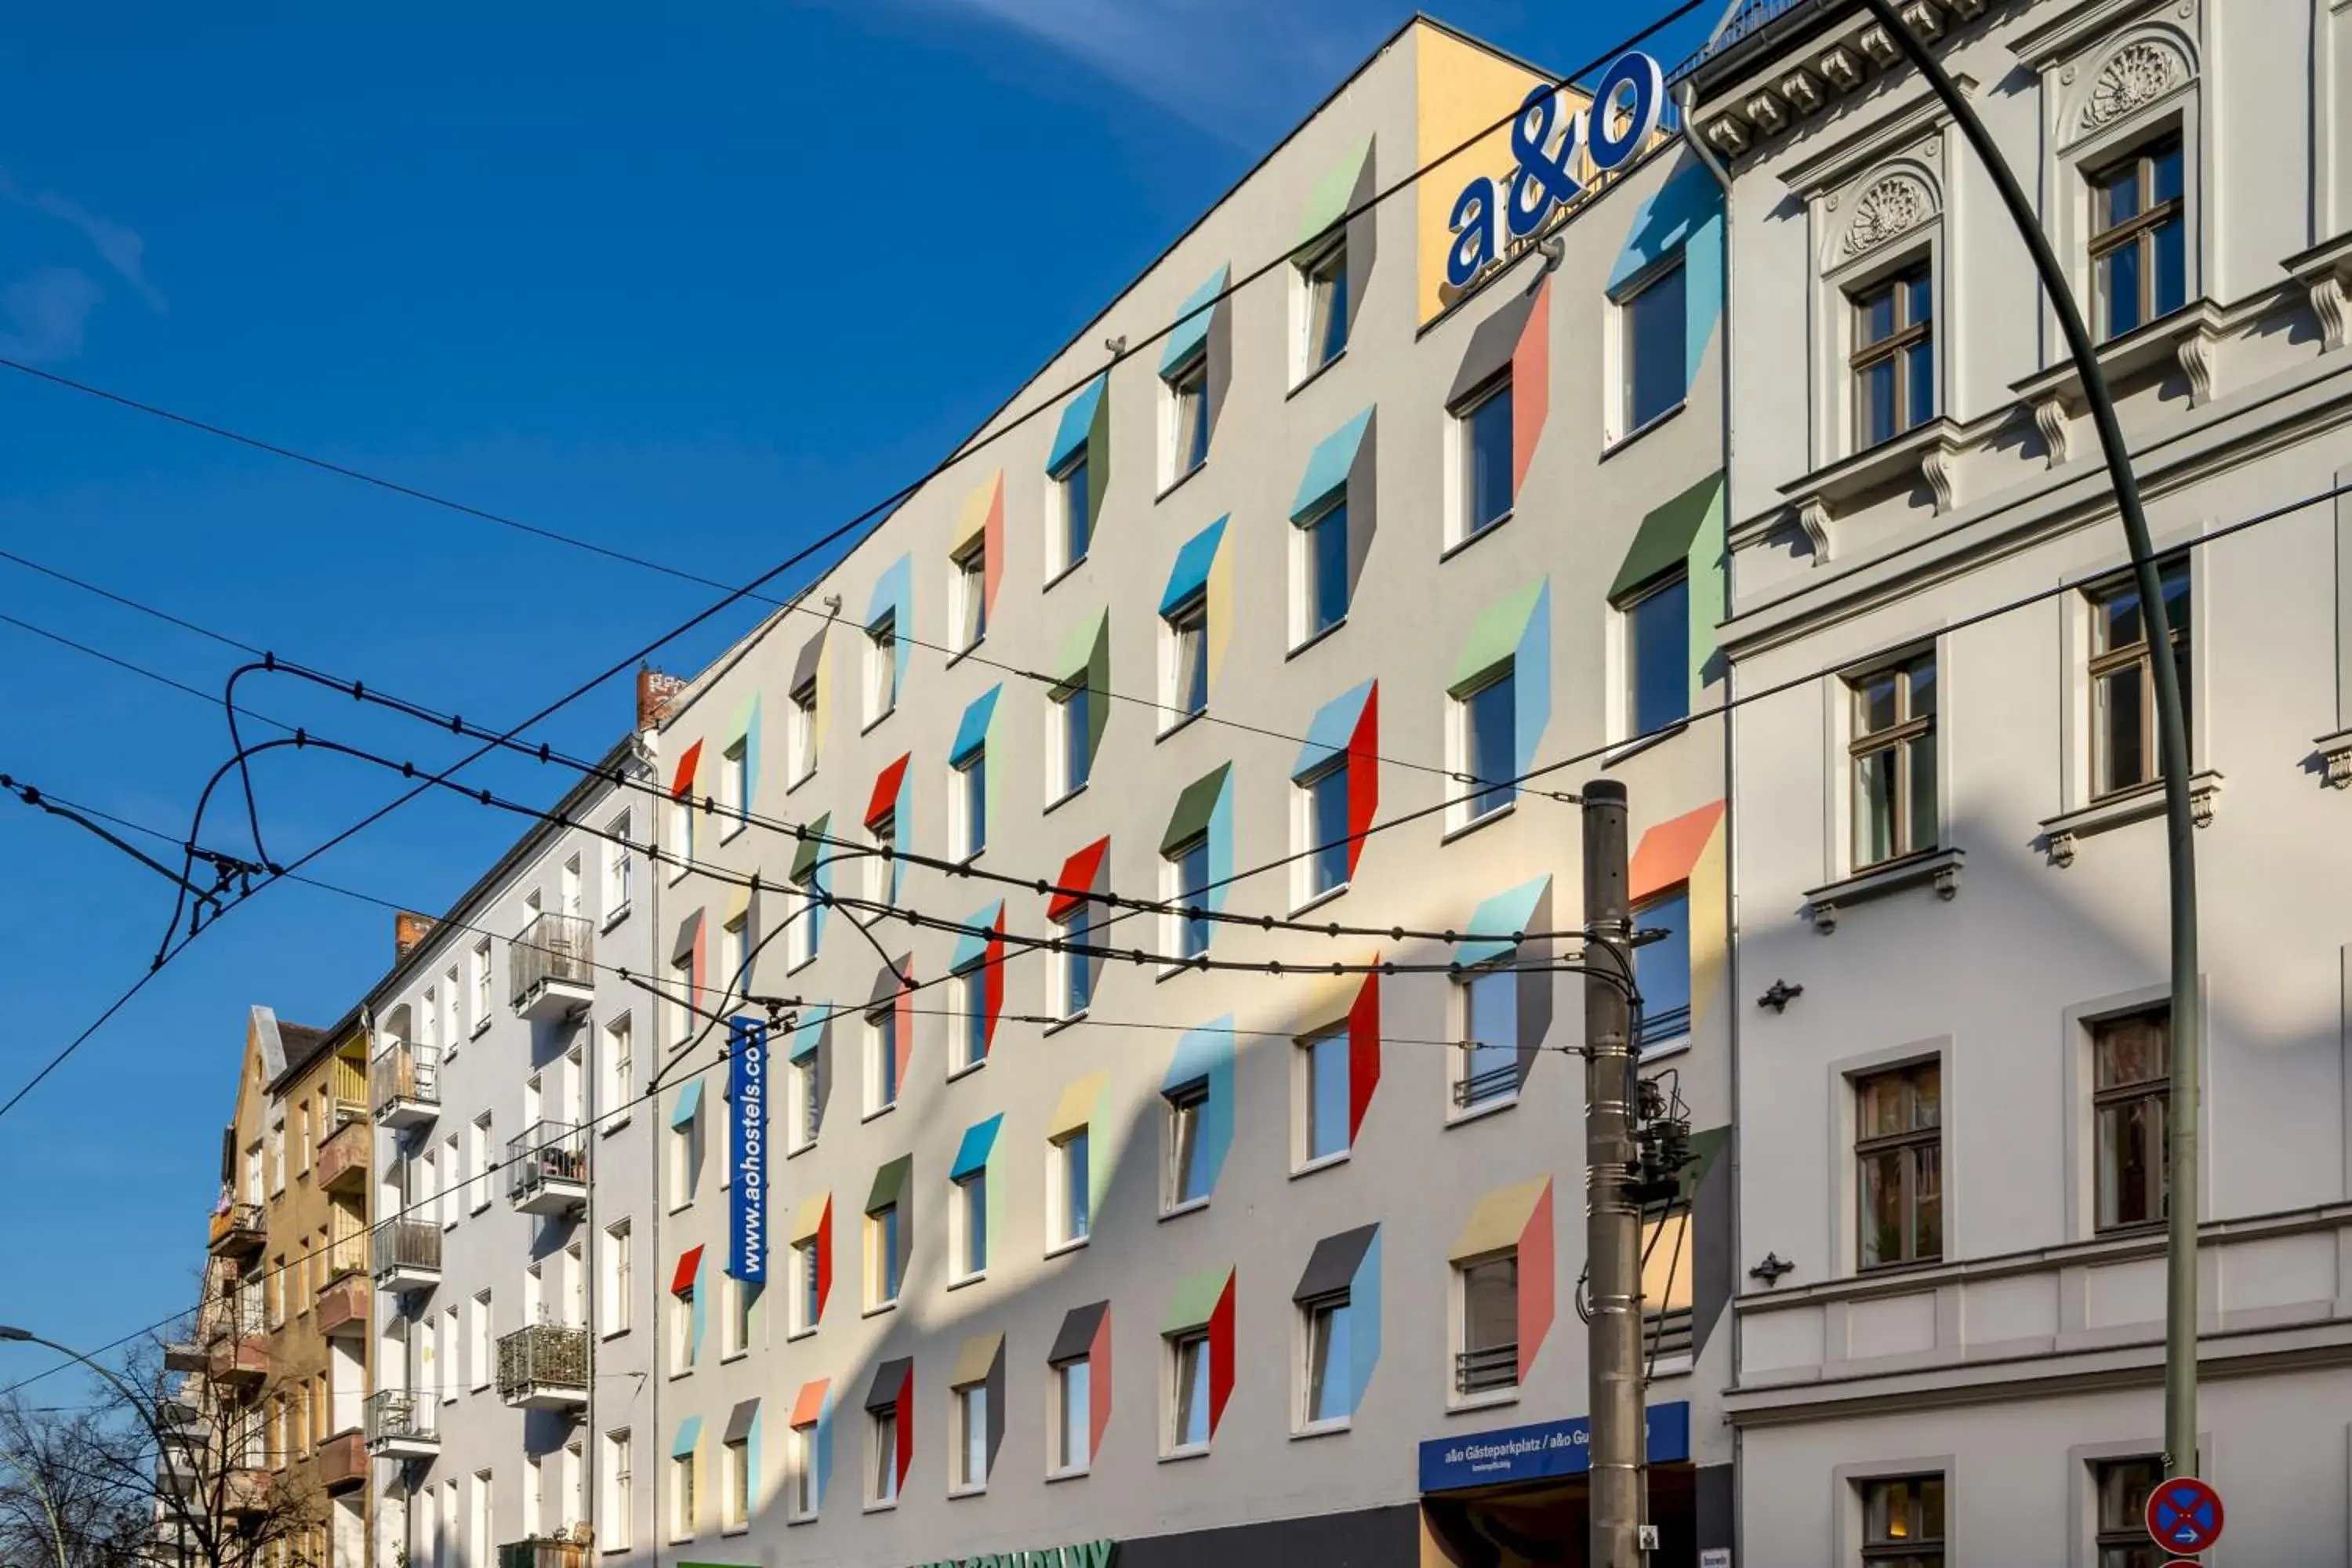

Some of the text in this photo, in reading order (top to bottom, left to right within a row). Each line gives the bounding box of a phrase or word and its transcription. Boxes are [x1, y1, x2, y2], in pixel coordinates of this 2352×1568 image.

[1447, 50, 1663, 288] a&o
[1445, 1448, 1464, 1463] a&o
[1465, 1437, 1541, 1459] Gästeparkplatz
[1549, 1432, 1571, 1448] a&o
